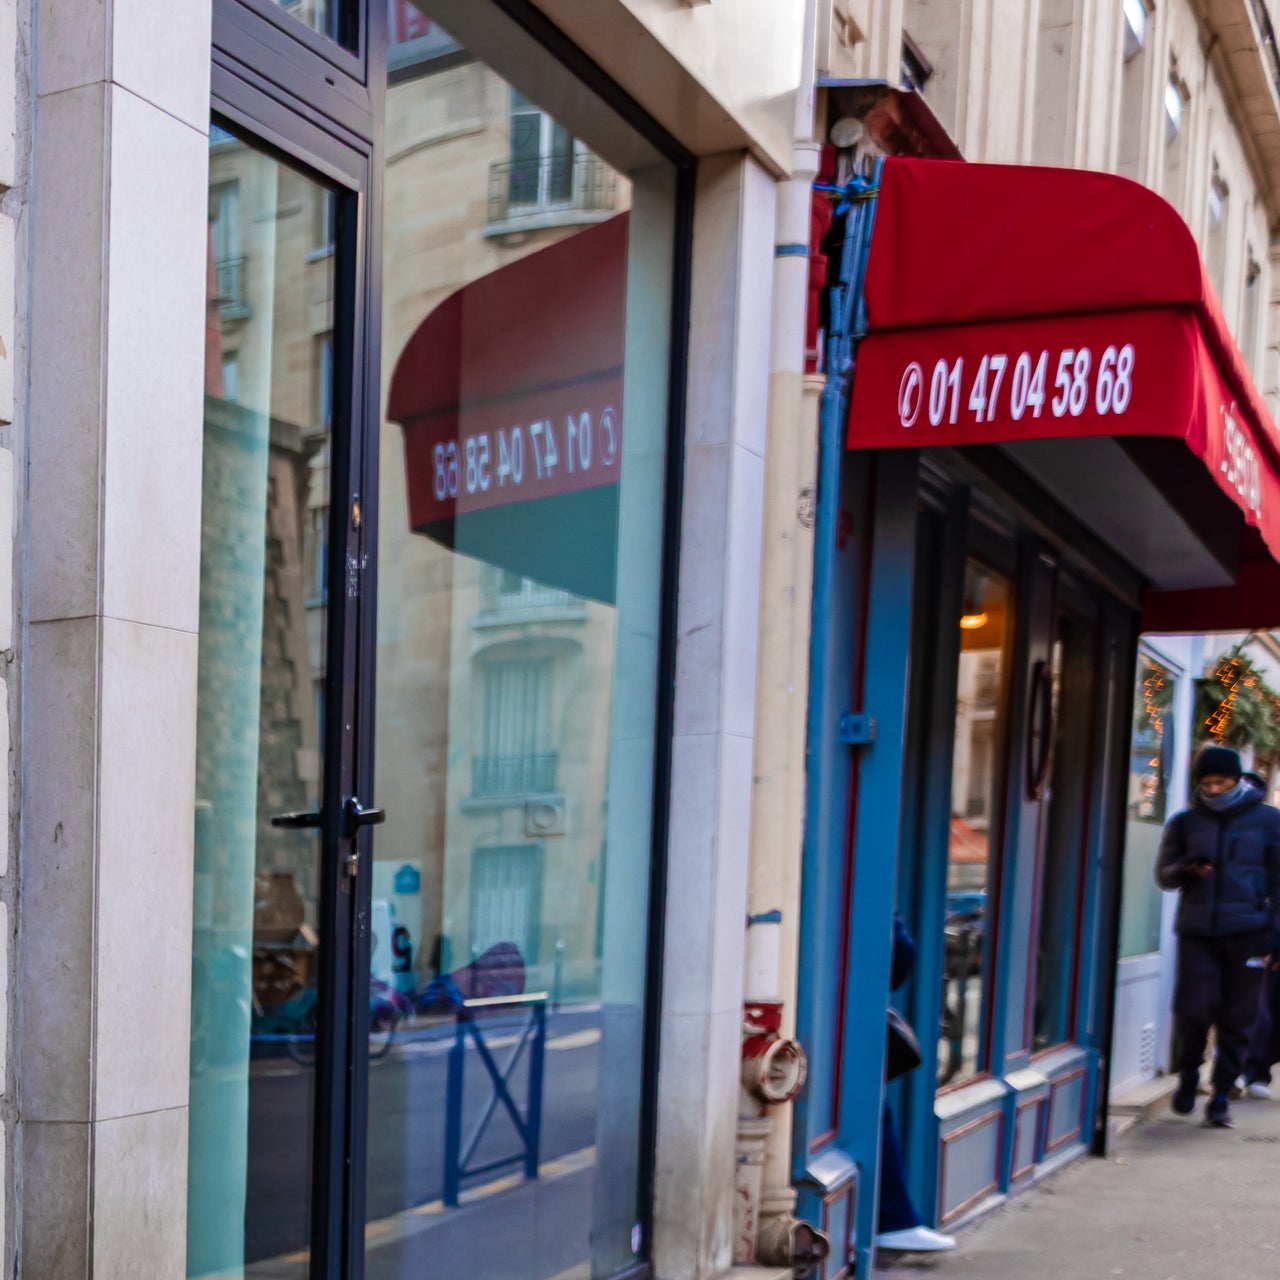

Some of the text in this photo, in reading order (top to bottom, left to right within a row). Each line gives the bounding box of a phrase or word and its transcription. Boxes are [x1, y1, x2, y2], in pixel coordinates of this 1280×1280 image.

[929, 343, 1135, 427] 01 47 04 58 68
